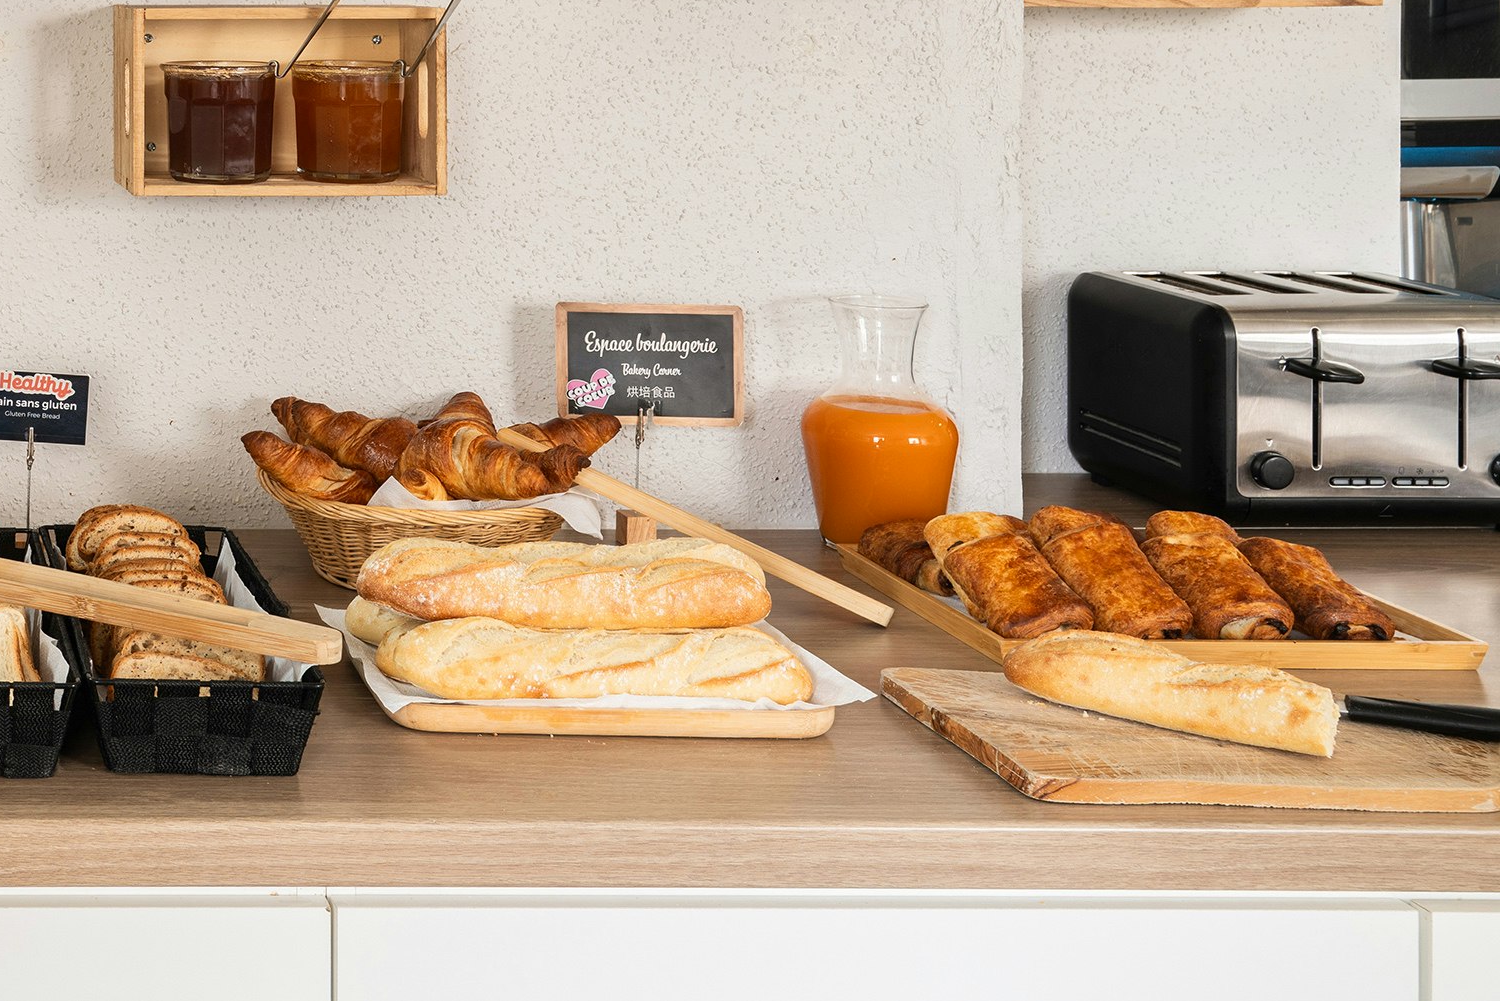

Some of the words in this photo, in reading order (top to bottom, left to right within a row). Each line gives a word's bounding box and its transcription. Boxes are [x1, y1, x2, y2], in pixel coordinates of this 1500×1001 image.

[584, 330, 634, 357] Espace
[636, 332, 718, 360] boulangerie
[621, 363, 651, 379] Bakery
[653, 363, 682, 377] Corner
[567, 381, 598, 398] COUP
[598, 374, 616, 387] DE
[627, 386, 676, 399] 烘培食品
[15, 399, 40, 409] sans
[41, 399, 77, 411] gluten
[576, 386, 616, 406] COEUR
